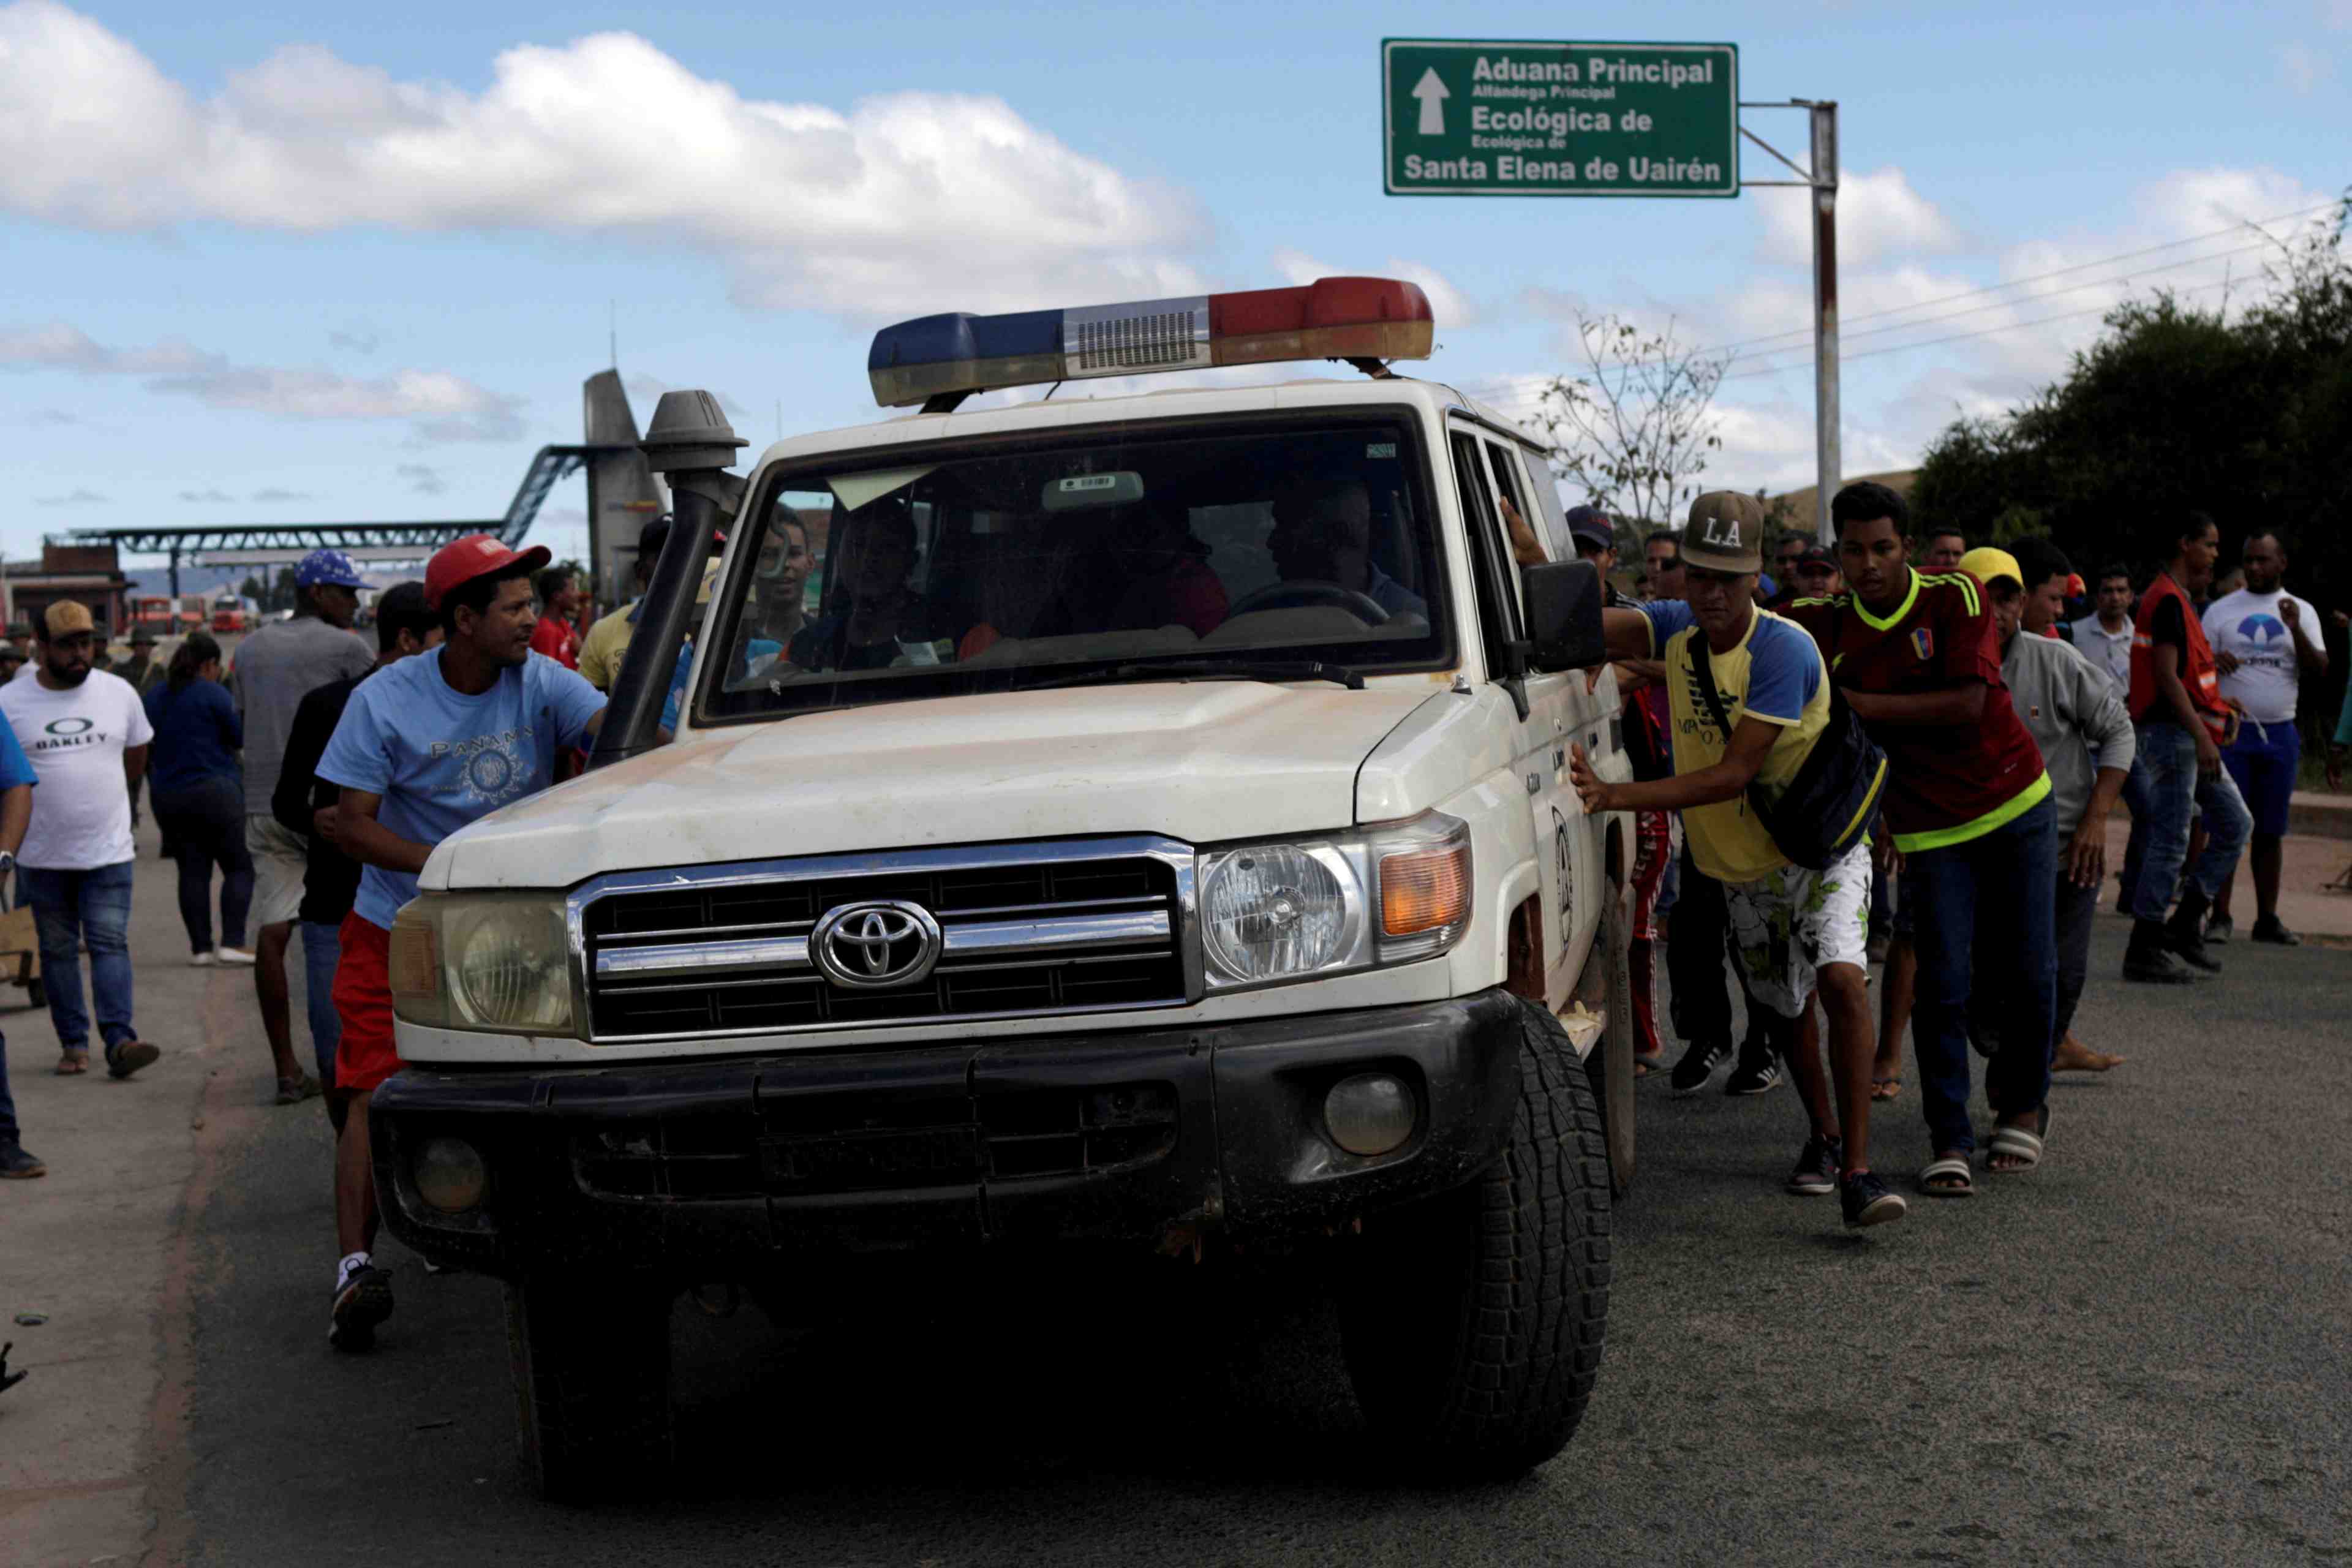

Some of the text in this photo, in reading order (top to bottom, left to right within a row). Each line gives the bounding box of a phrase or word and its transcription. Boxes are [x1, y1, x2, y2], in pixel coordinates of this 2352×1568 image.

[1473, 57, 1713, 89] Aduana Principal
[1551, 85, 1615, 102] Principal
[1472, 106, 1653, 136] Ecológica de
[1471, 134, 1567, 151] Ecológica de
[1404, 155, 1721, 182] Santa Elena de Uairén
[1702, 517, 1742, 548] LA
[36, 733, 107, 750] OAKLEY
